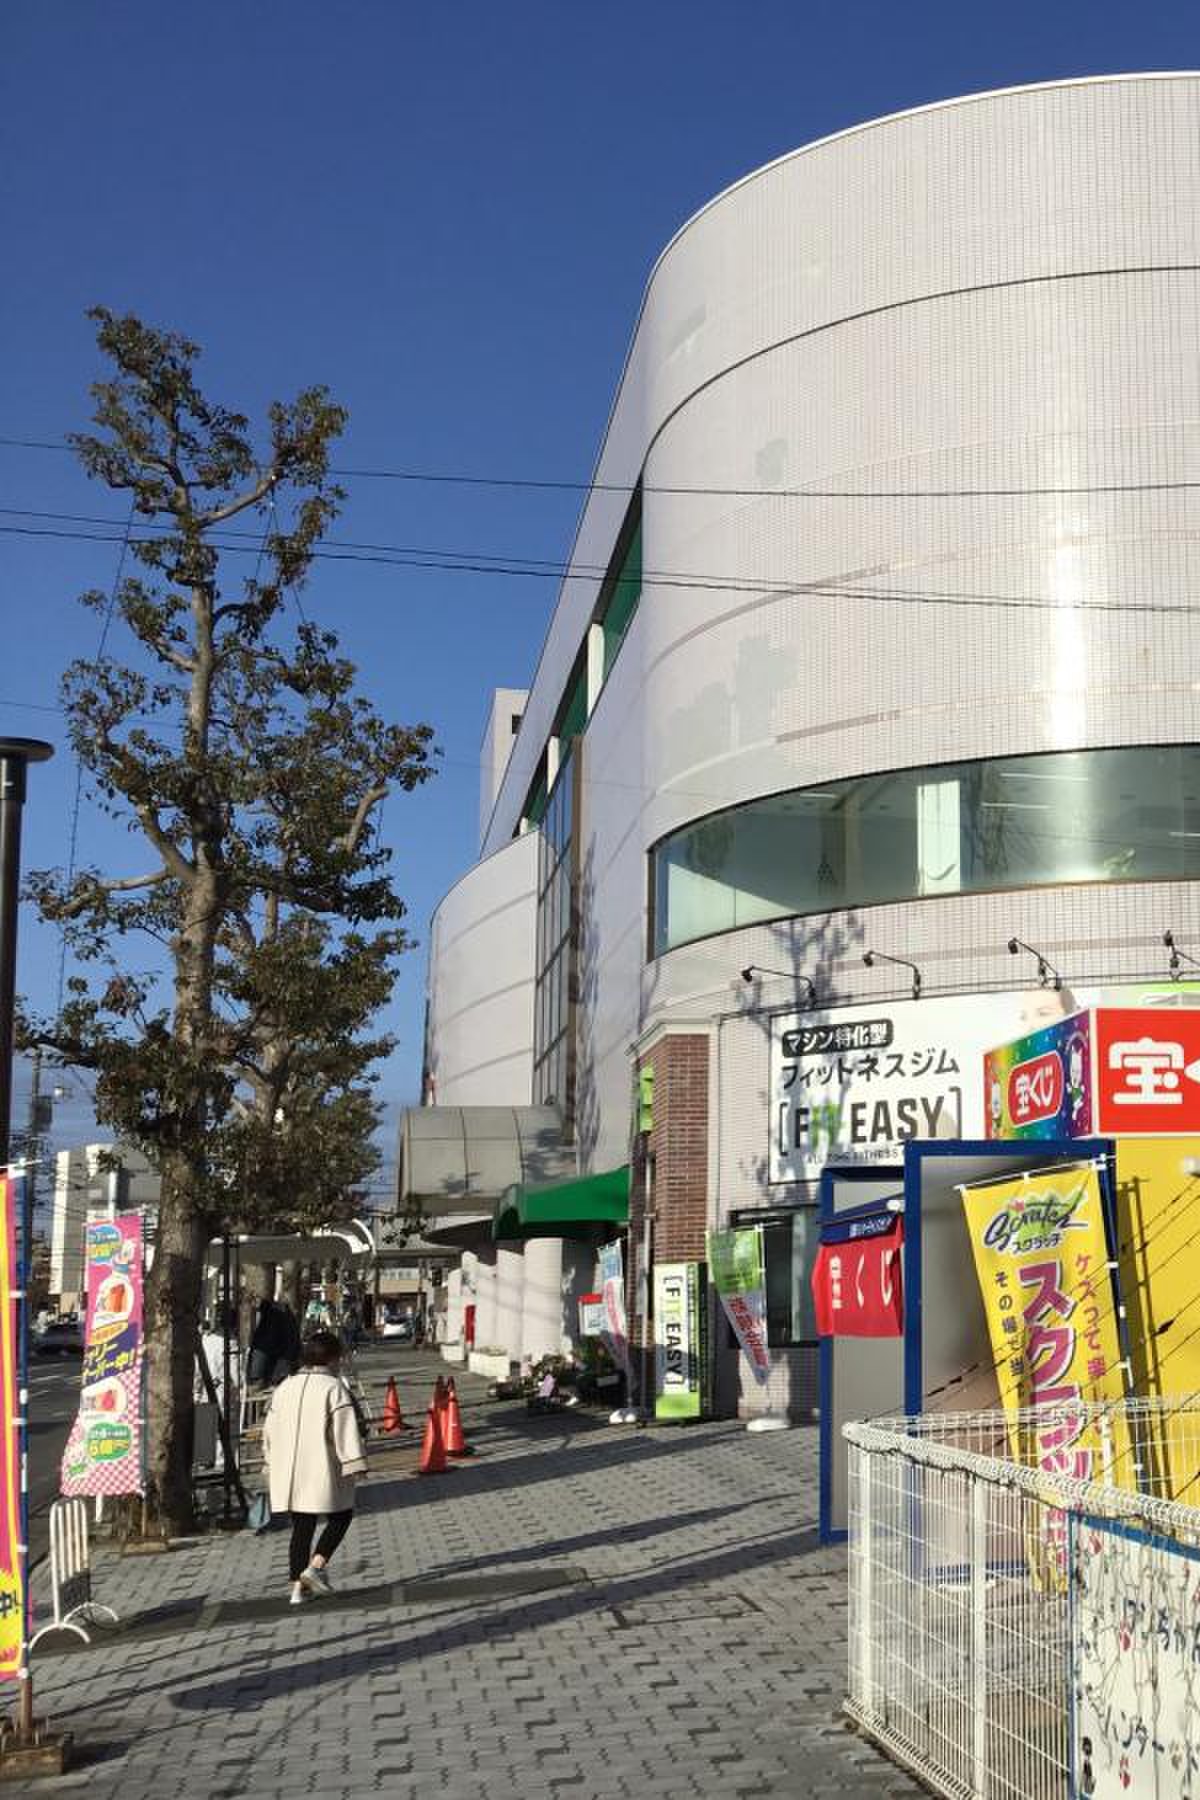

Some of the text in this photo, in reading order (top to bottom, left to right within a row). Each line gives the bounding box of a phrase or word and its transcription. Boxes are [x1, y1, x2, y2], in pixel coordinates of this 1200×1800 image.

[785, 1023, 889, 1053] マシン特化型
[781, 1047, 961, 1090] フィットネスジム
[1014, 1063, 1055, 1117] 宝くじ
